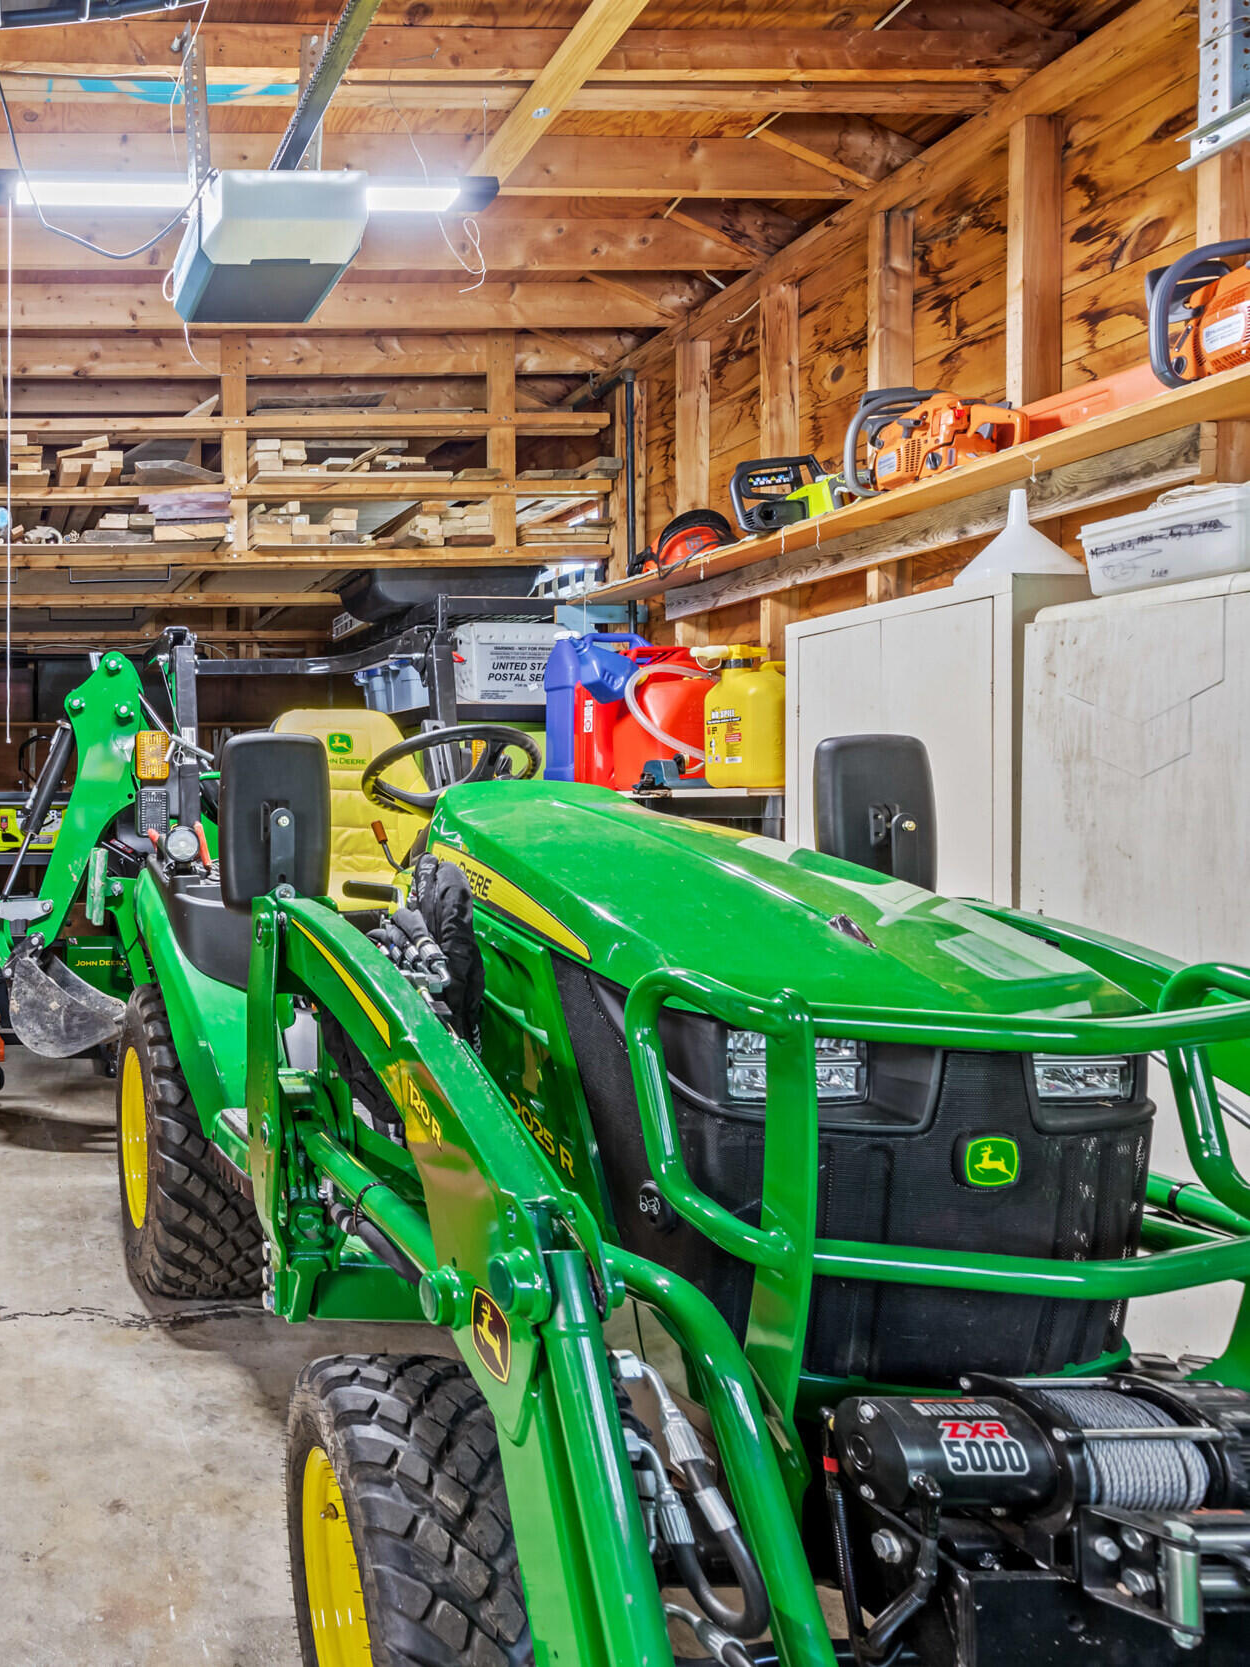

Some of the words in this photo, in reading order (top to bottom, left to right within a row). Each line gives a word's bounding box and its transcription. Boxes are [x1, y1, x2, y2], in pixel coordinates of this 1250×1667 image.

[492, 662, 528, 671] UNITED
[488, 673, 526, 682] POSTAL
[339, 757, 367, 765] DEERE
[910, 1403, 1000, 1416] BADLAND
[940, 1421, 1010, 1439] ZXR
[943, 1440, 1028, 1473] 5000
